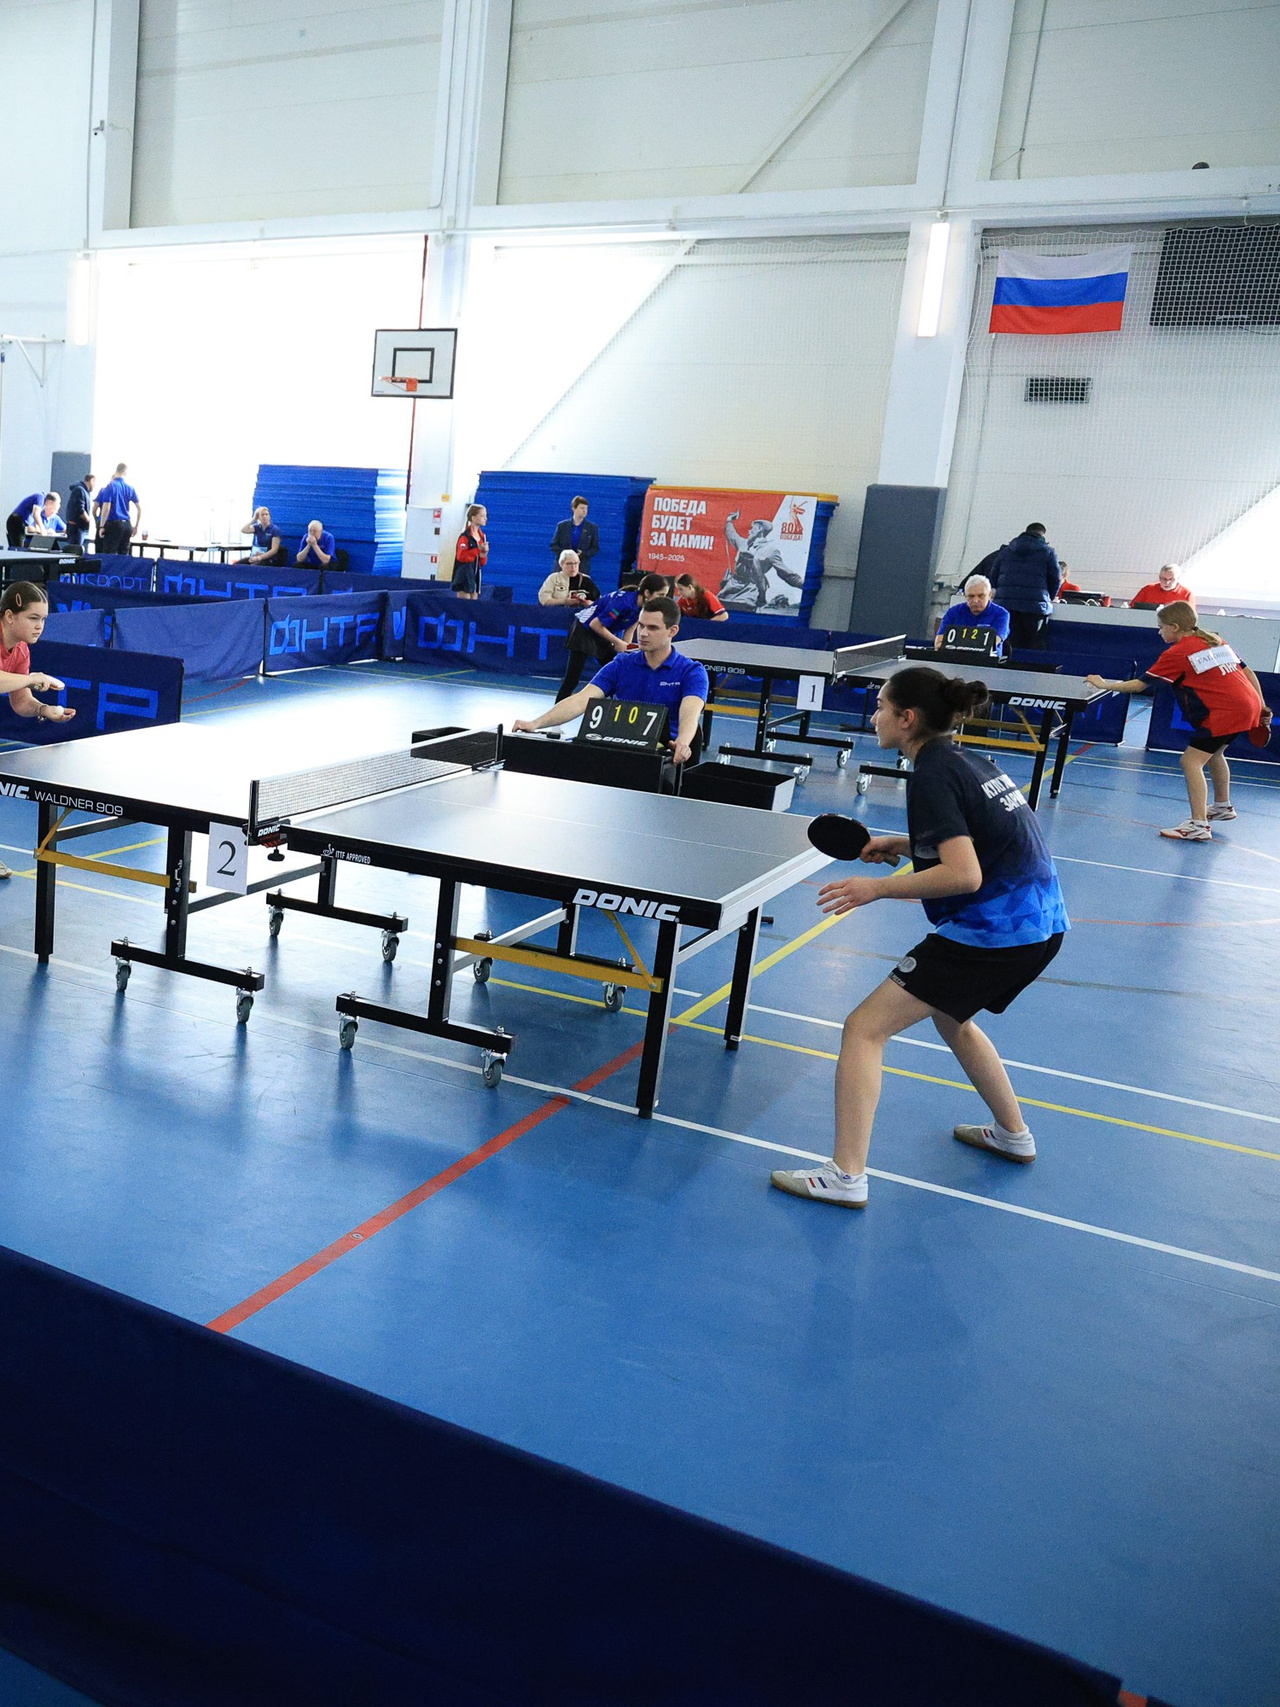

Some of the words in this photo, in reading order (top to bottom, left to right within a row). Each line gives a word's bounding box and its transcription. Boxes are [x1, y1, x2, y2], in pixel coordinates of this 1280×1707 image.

[653, 497, 707, 516] ПОБЕДА
[651, 514, 693, 532] БУДЕТ
[649, 532, 667, 547] ЗА
[670, 534, 715, 551] НАМИ!
[947, 628, 957, 643] 0
[962, 628, 968, 639] 1
[970, 628, 979, 640] 2
[983, 631, 990, 646] 1
[727, 666, 746, 675] 909
[810, 684, 817, 703] 1
[1008, 696, 1067, 710] DONIC
[589, 705, 603, 729] 9
[614, 704, 622, 722] 1
[628, 706, 638, 724] 0
[642, 711, 658, 736] 7
[601, 737, 649, 747] DONIC
[34, 790, 95, 812] WALDNER
[96, 801, 124, 817] 909
[258, 824, 281, 837] DONIC
[216, 840, 237, 876] 2
[346, 852, 371, 865] APPROVED
[572, 888, 681, 922] DONIC
